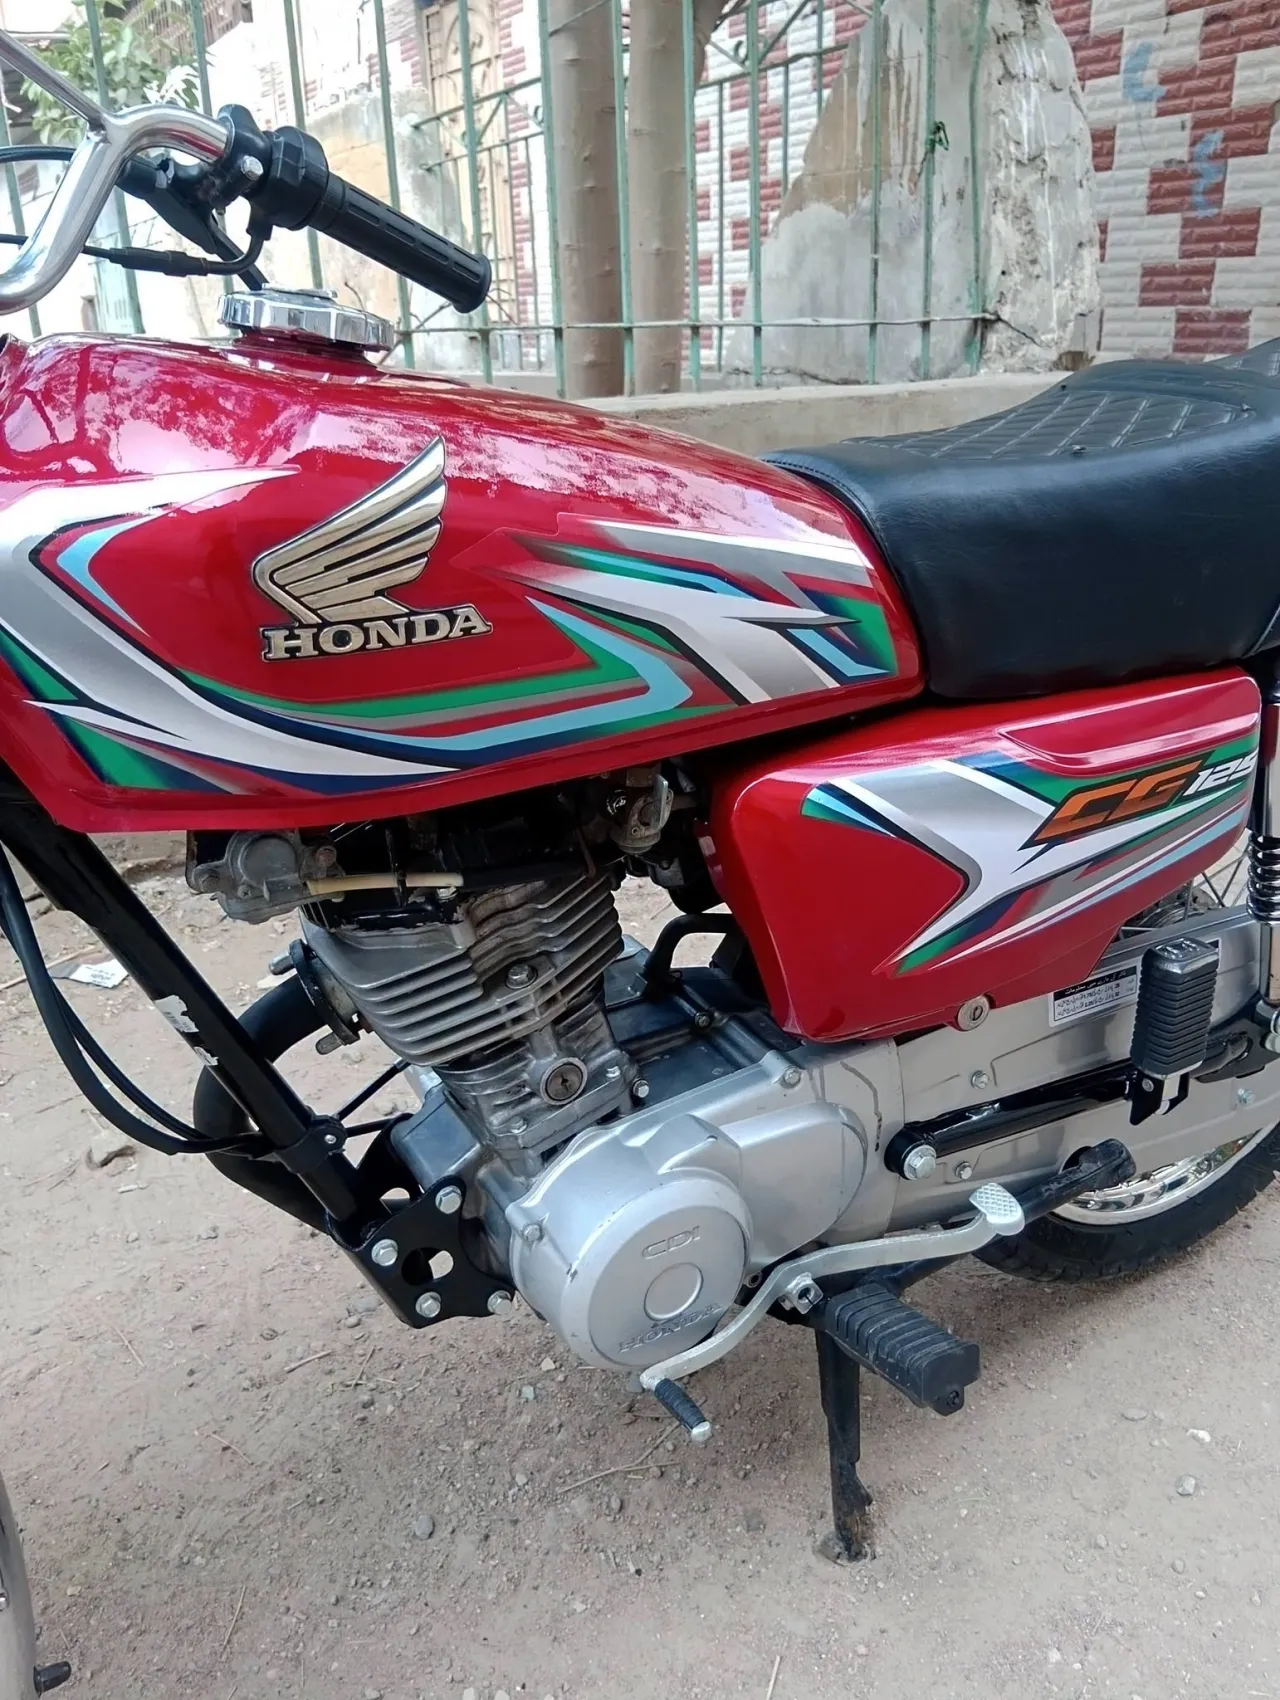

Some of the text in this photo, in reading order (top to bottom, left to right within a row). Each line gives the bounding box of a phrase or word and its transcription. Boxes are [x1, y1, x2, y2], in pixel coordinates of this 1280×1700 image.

[263, 607, 490, 660] HONDA
[1035, 748, 1258, 841] CG 125
[642, 1226, 700, 1259] CDI
[618, 1302, 722, 1353] HONDA
